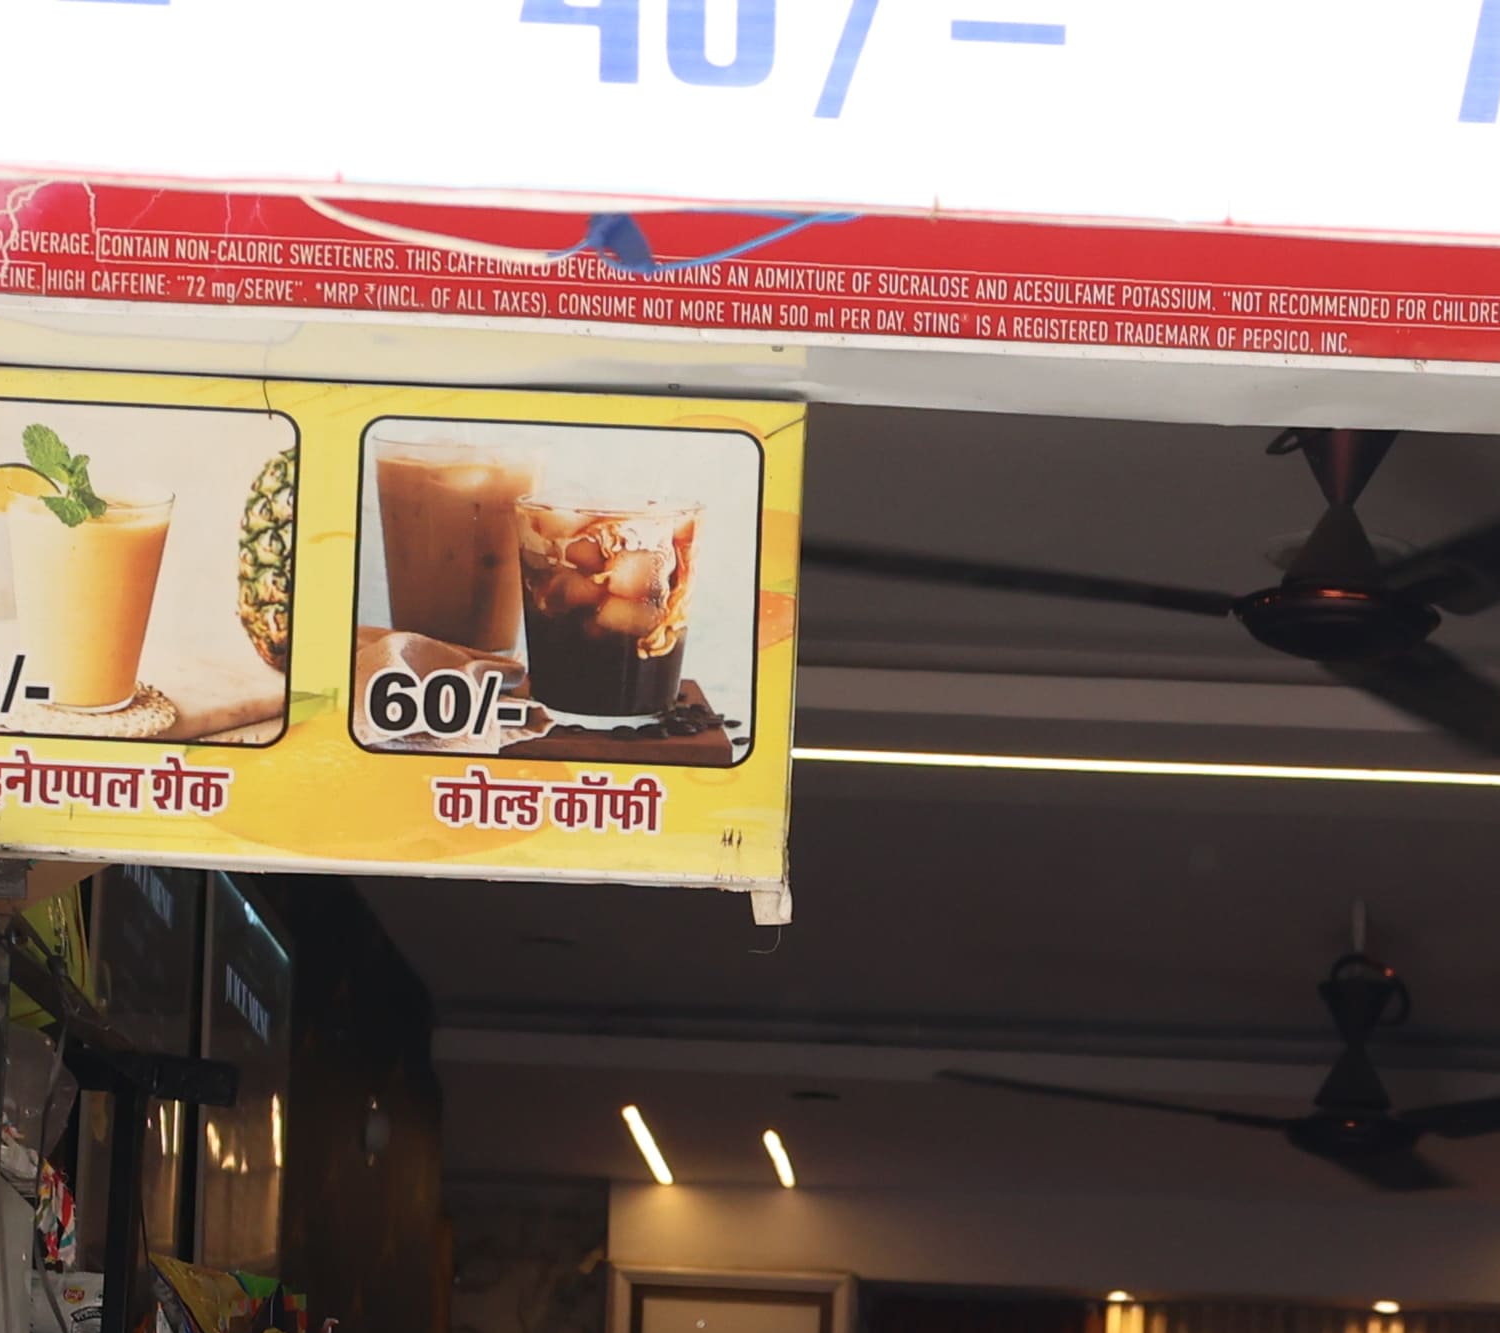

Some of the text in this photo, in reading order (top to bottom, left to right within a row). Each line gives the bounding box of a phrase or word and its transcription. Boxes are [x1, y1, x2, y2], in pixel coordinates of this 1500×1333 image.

[10, 230, 96, 255] BEVERAGE.
[101, 233, 169, 259] CONTAIN
[175, 236, 283, 264] NON-CALORIC
[290, 243, 398, 269] SWEETENERS.
[407, 249, 442, 272] THIS
[727, 264, 750, 287] AN
[755, 266, 846, 293] ADMIXTURE
[852, 271, 873, 294] OF
[877, 272, 969, 298] SUCRALOSE
[976, 278, 1008, 300] AND
[1013, 279, 1116, 306] ACESULFAME
[1121, 285, 1217, 311] POTASSIUM.
[1268, 292, 1391, 319] RECOMMENDED
[1396, 298, 1426, 321] FOR
[47, 268, 86, 292] HIGH
[91, 270, 171, 296] CAFFEINE:
[431, 286, 452, 309] OF
[457, 288, 486, 311] ALL
[492, 289, 553, 316] TAXES).
[558, 293, 637, 318] CONSUME
[642, 296, 674, 320] NOT
[680, 298, 725, 322] MORE
[731, 301, 774, 325] THAN
[779, 304, 810, 327] 500
[814, 305, 835, 328] ml
[840, 307, 871, 330] PER
[876, 309, 907, 332] DAY.
[975, 314, 991, 337] IS
[996, 315, 1008, 337] A
[1013, 316, 1109, 343] REGISTERED
[1114, 321, 1209, 348] TRADEMARK
[1216, 326, 1237, 349] OF
[1320, 331, 1353, 355] INC.
[368, 669, 523, 737] 60/-
[150, 756, 229, 811] शेक
[436, 766, 661, 832] कोल्ड कॉफी
